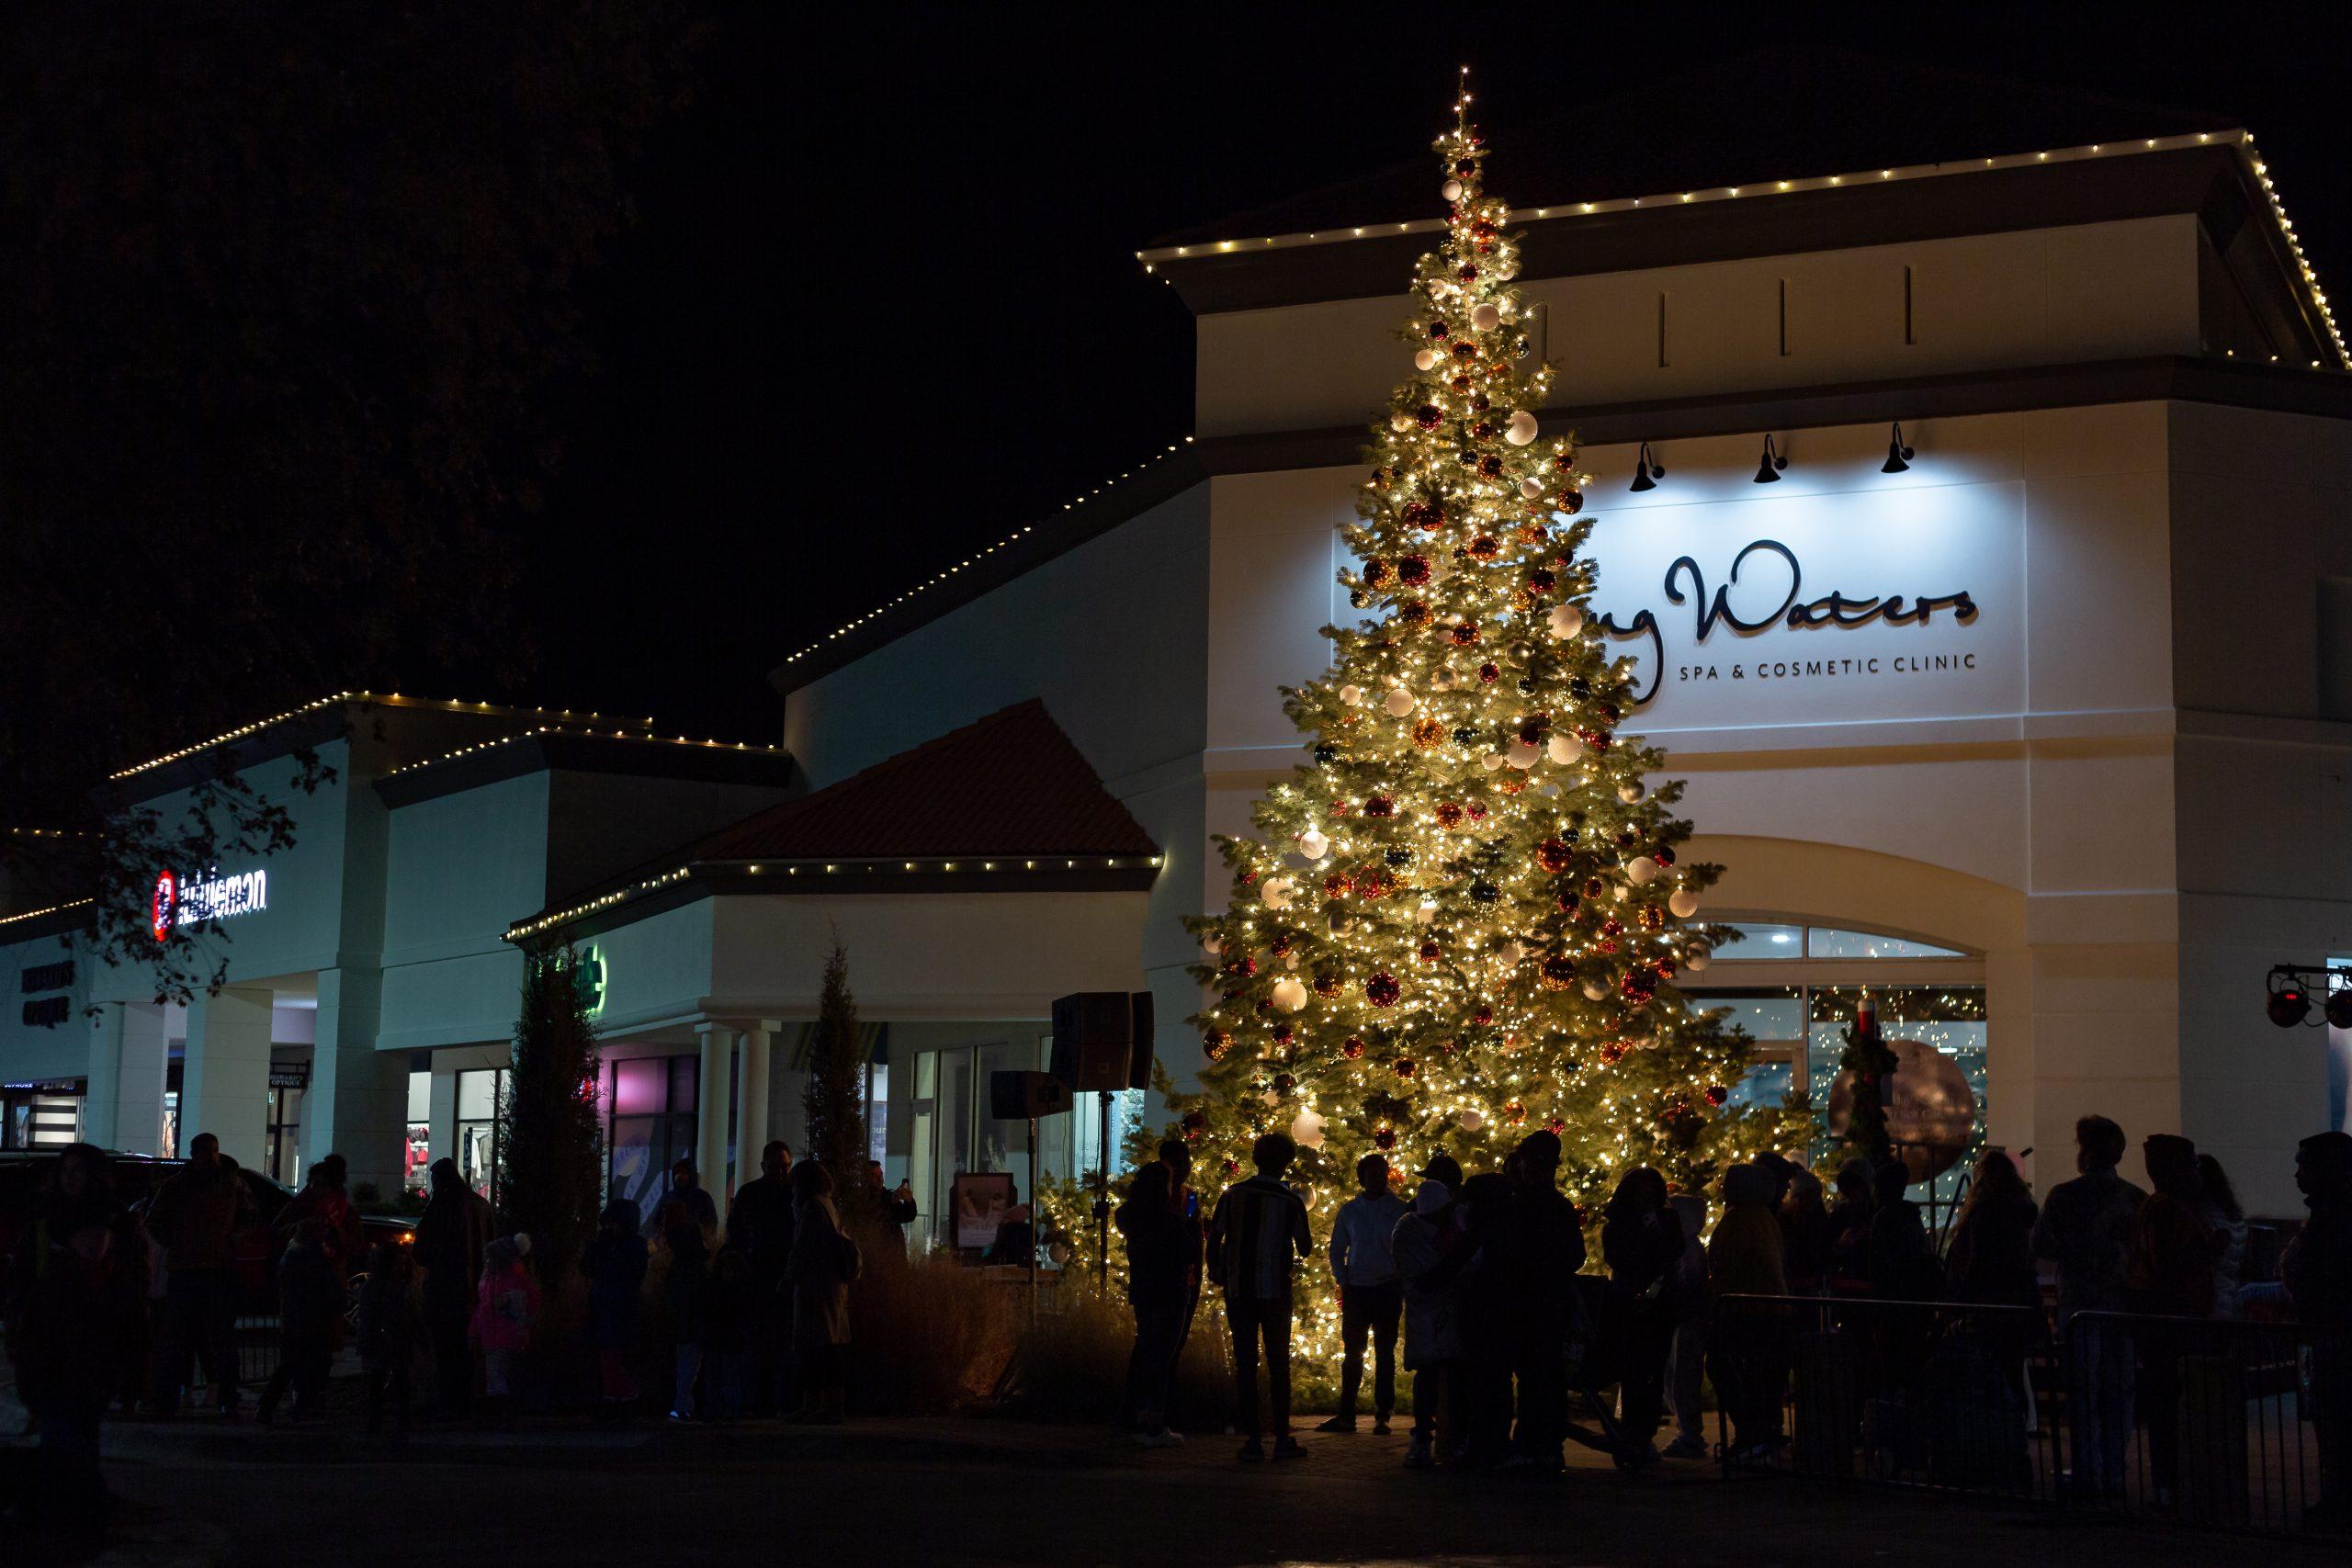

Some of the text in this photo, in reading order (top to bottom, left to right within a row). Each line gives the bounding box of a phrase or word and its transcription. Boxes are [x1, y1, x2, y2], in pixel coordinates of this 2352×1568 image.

[1664, 539, 1978, 641] Waters
[1679, 653, 1975, 682] SPA & COSMETIC CLINIC
